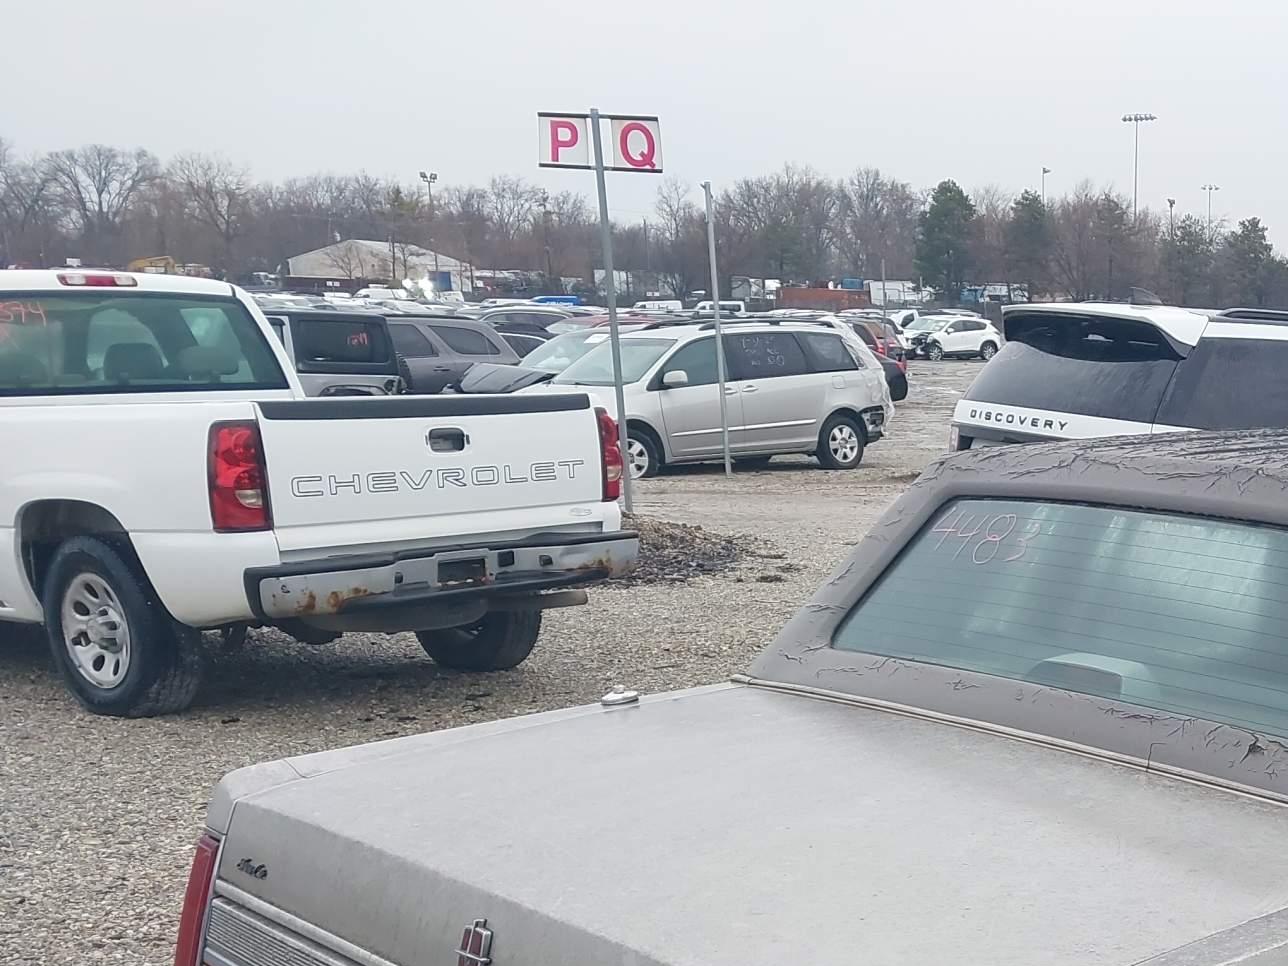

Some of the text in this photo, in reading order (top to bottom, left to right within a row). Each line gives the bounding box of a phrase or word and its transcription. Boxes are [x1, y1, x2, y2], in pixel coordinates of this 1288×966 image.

[550, 120, 578, 162] P
[619, 122, 656, 168] Q
[969, 408, 1069, 432] DISCOVERY
[291, 459, 585, 498] CHEVROLET
[932, 506, 1041, 565] 4483
